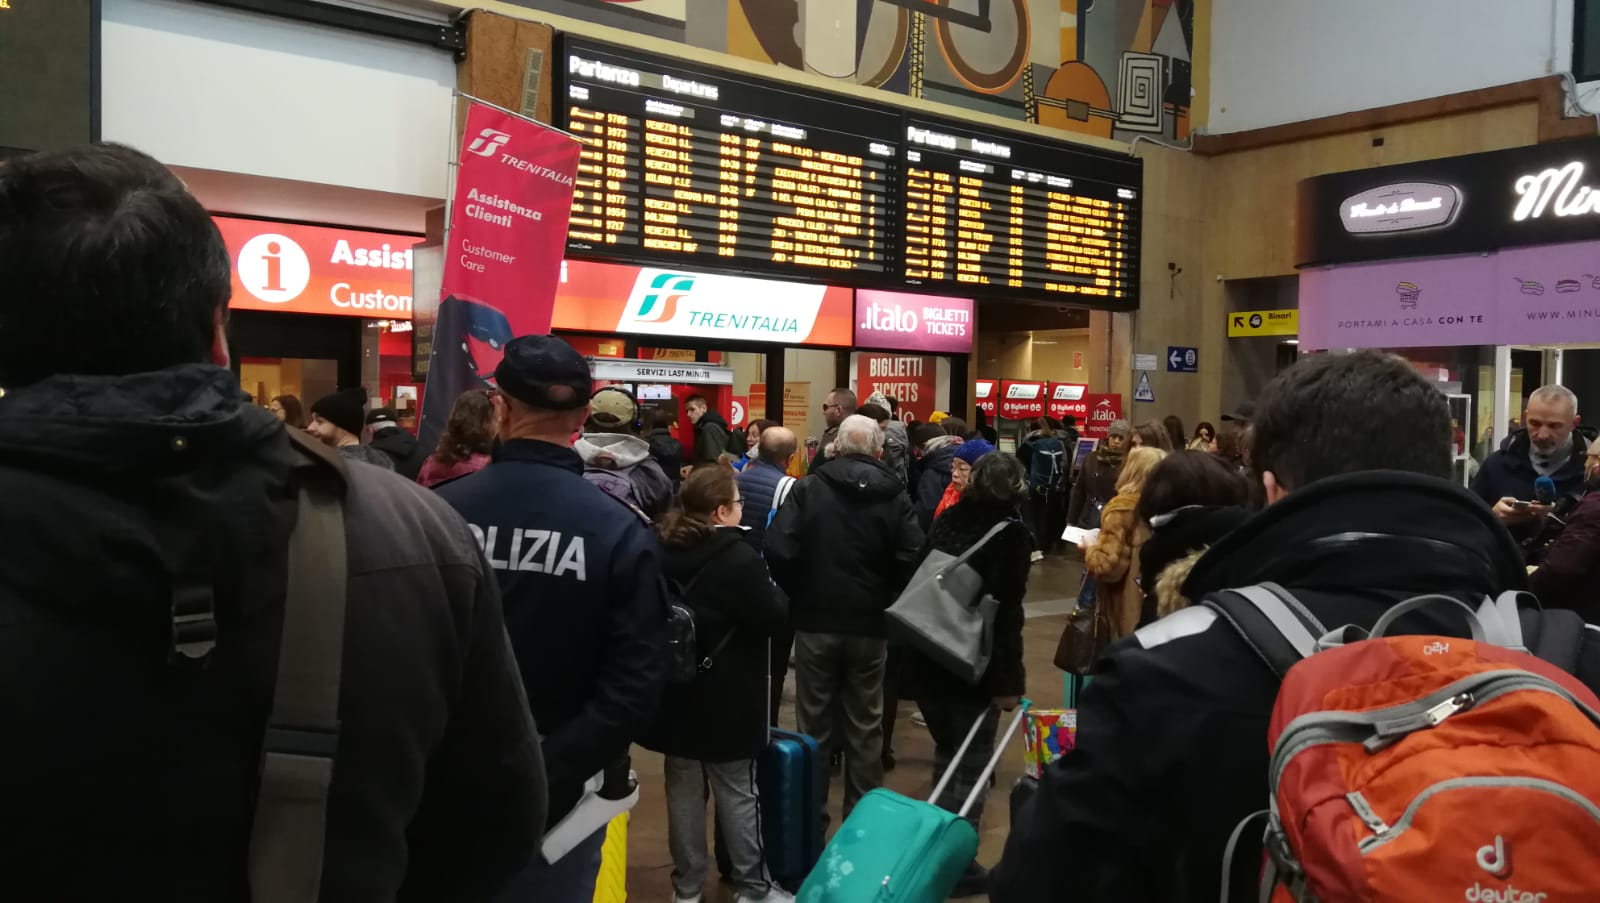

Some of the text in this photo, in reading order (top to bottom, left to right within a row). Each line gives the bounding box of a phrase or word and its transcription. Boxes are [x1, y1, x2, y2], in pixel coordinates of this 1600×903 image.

[663, 75, 718, 99] Departures
[501, 153, 573, 187] TRENITALIA
[467, 188, 542, 221] Assistenza
[465, 203, 512, 228] Clienti
[462, 239, 516, 265] Customer
[460, 254, 485, 273] Care
[688, 310, 798, 333] TRENITALIA
[922, 306, 969, 324] BIGLIETTI
[1268, 311, 1292, 320] Binari
[1338, 319, 1386, 329] PORTAMI
[1403, 317, 1433, 327] CASA
[1438, 316, 1464, 325] CON
[1470, 315, 1484, 323] TE
[926, 321, 966, 337] TICKETS
[636, 367, 666, 377] SERVIZI
[668, 369, 684, 378] LAST
[869, 357, 923, 377] BIGLIETTI
[872, 382, 919, 403] TICKETS
[1465, 883, 1547, 903] deuter
